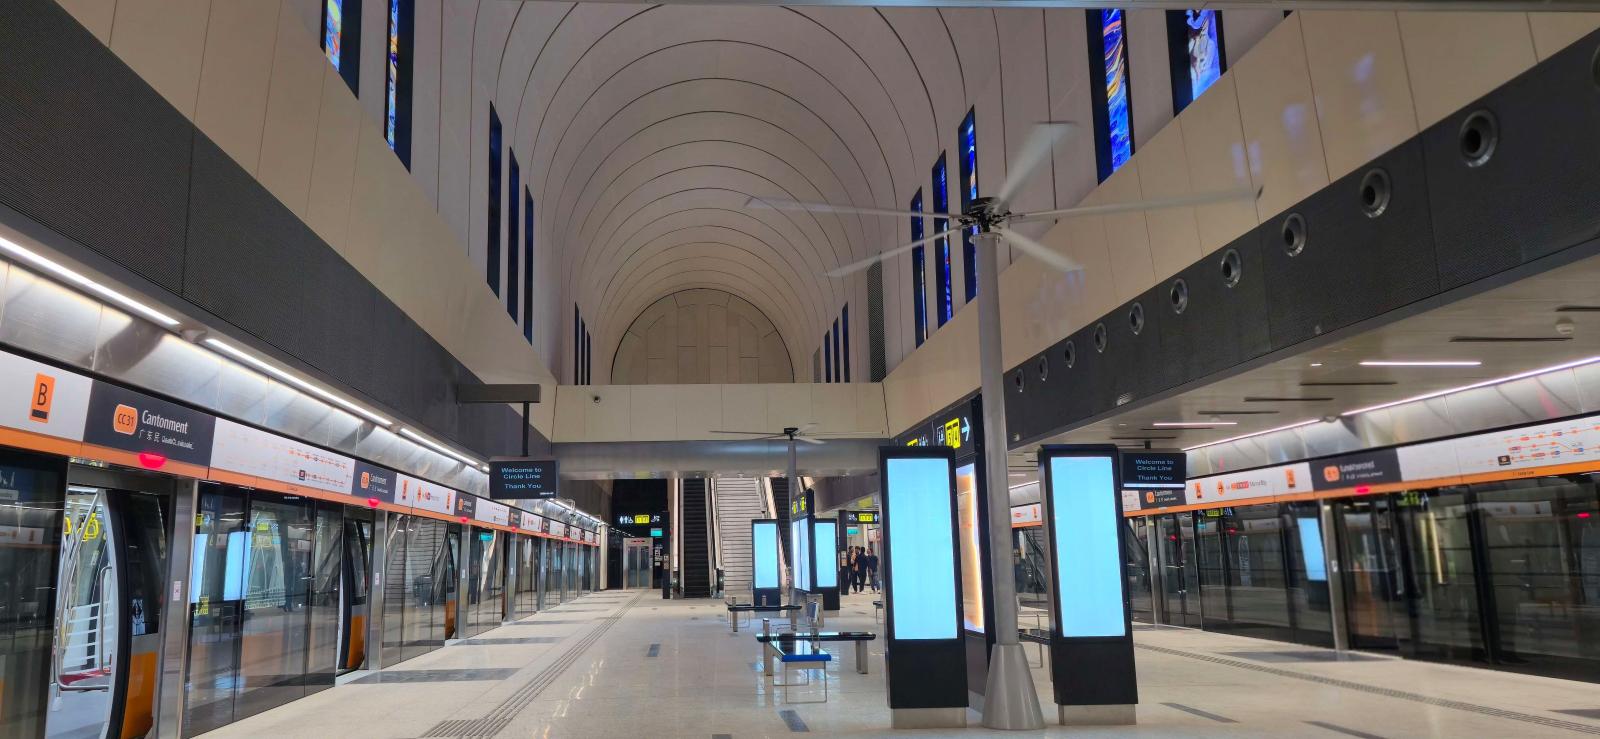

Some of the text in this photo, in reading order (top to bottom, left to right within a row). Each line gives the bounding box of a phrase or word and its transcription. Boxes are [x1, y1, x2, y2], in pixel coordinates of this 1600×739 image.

[37, 383, 47, 406] B
[117, 413, 134, 427] CC31
[141, 409, 188, 435] Cantonment
